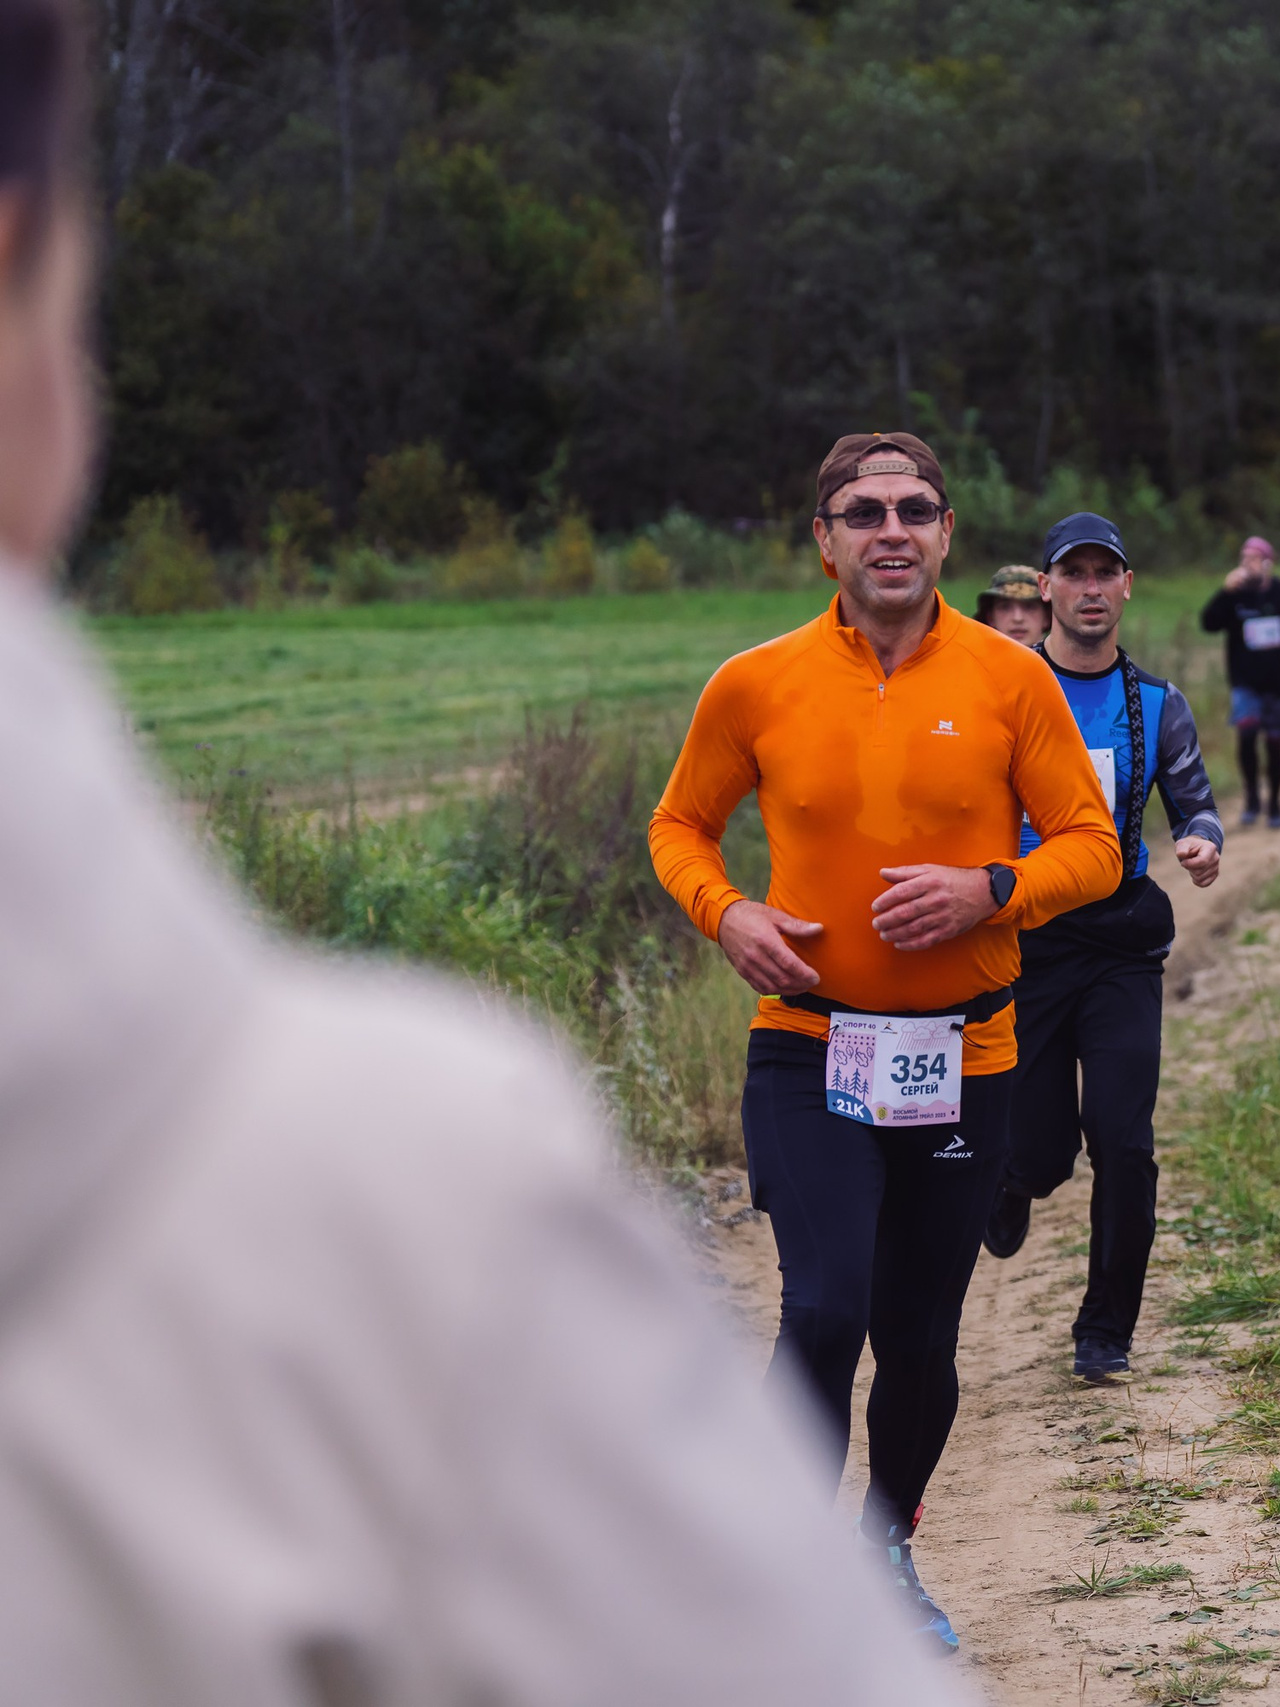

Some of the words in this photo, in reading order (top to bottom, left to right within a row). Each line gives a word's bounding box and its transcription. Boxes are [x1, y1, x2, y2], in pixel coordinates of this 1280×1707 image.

[842, 1021, 867, 1029] СПОРТ
[890, 1052, 948, 1084] 354
[900, 1081, 939, 1096] СЕРГЕЙ
[836, 1098, 866, 1119] 21K
[892, 1107, 919, 1115] ВОСЬМОЙ
[932, 1151, 974, 1159] DEMIX
